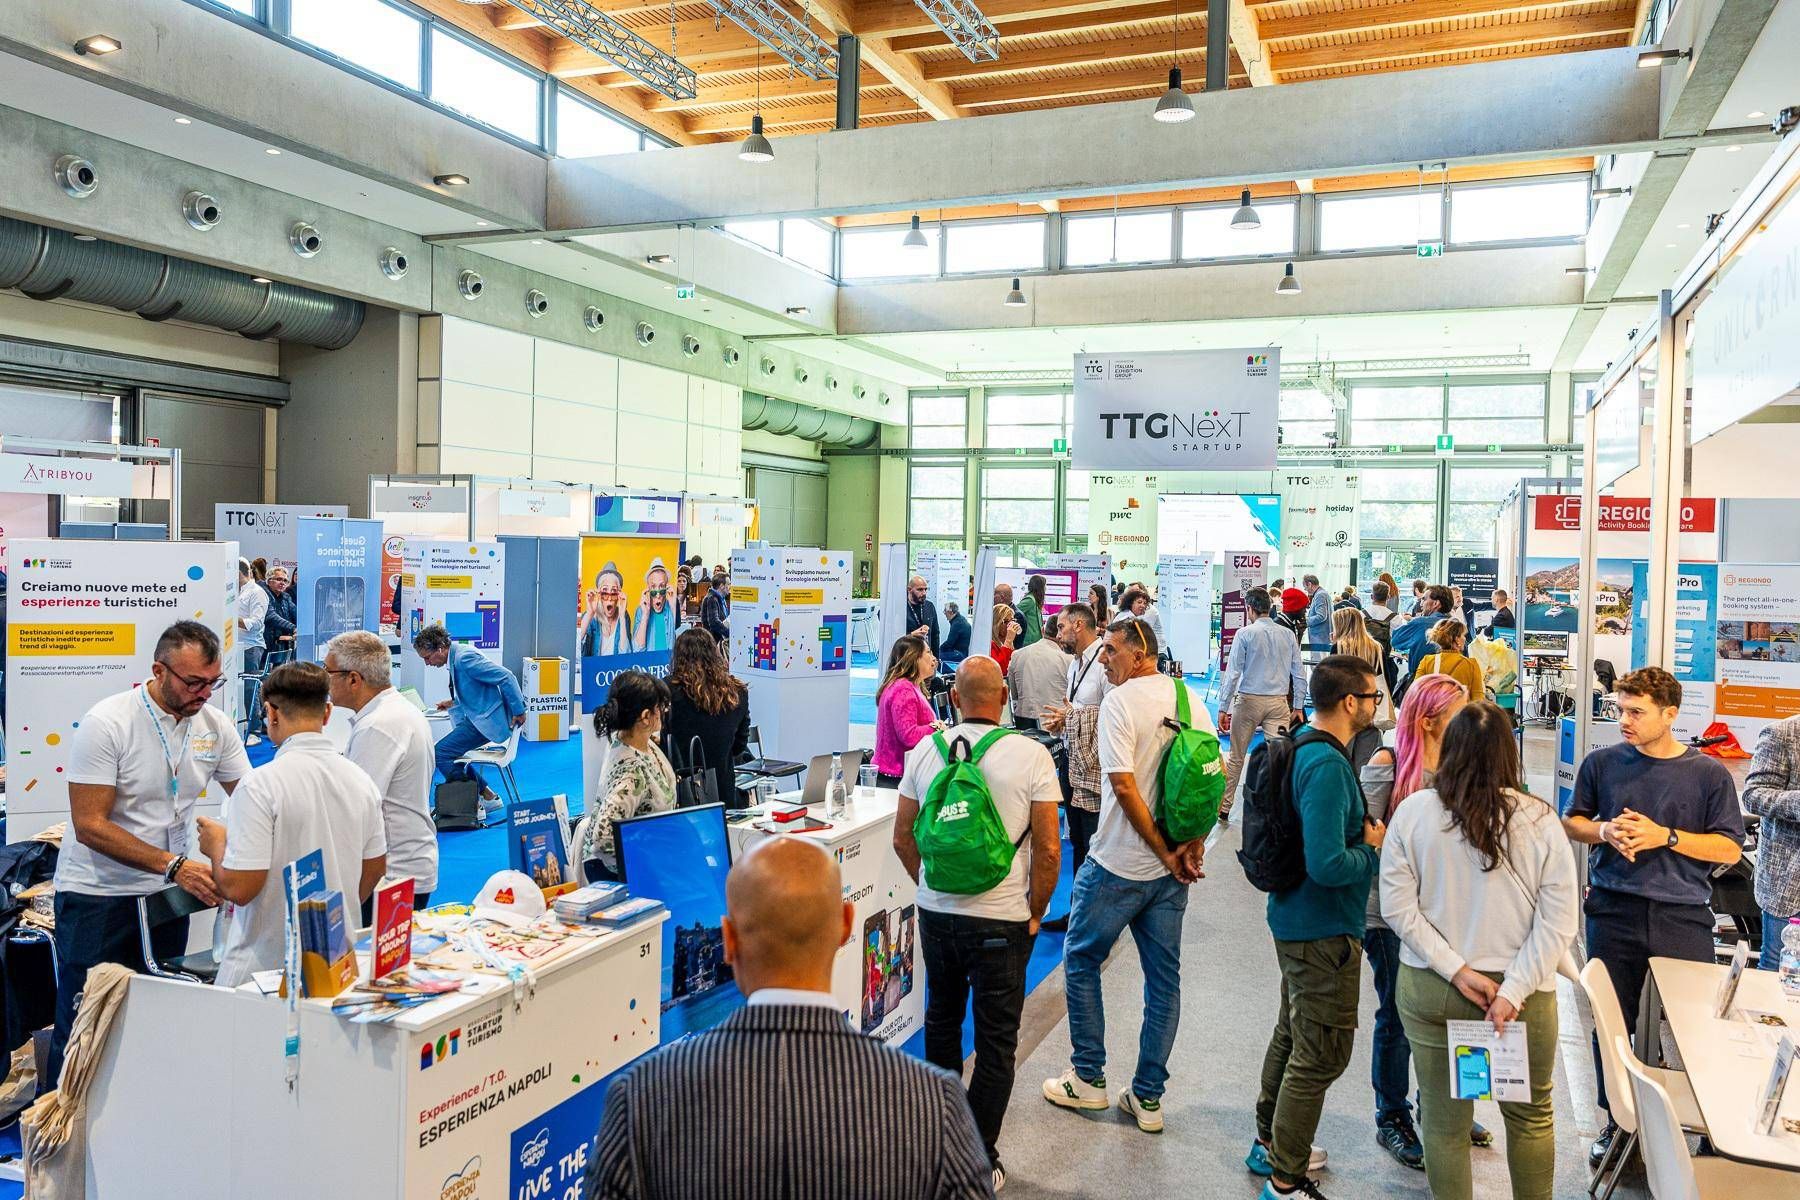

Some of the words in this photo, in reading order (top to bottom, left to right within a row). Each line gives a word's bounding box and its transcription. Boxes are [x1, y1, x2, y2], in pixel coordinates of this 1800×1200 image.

[1085, 365, 1103, 373] TTG
[1172, 443, 1242, 451] STARTUP
[1109, 511, 1132, 521] pwc
[1598, 522, 1625, 530] Activity
[1113, 535, 1150, 543] REGIONDO
[21, 581, 82, 593] Creiamo
[85, 584, 128, 593] nuove
[131, 583, 166, 593] mete
[170, 583, 187, 593] ed
[21, 597, 101, 609] esperienze
[104, 597, 178, 608] turistiche!
[1558, 770, 1574, 781] CARTA
[861, 884, 874, 897] CITY
[639, 942, 651, 958] 31
[467, 1015, 503, 1038] STARTUP
[467, 1025, 503, 1048] TURISMO
[419, 1083, 480, 1124] Experience
[489, 1069, 507, 1087] T.O.
[419, 1090, 506, 1149] ESPERIENZA
[508, 1062, 552, 1100] NAPOLI
[559, 1142, 588, 1181] THE
[440, 1169, 481, 1200] ESPERIENZA
[517, 1166, 553, 1200] LIVE
[564, 1176, 585, 1200] OF
